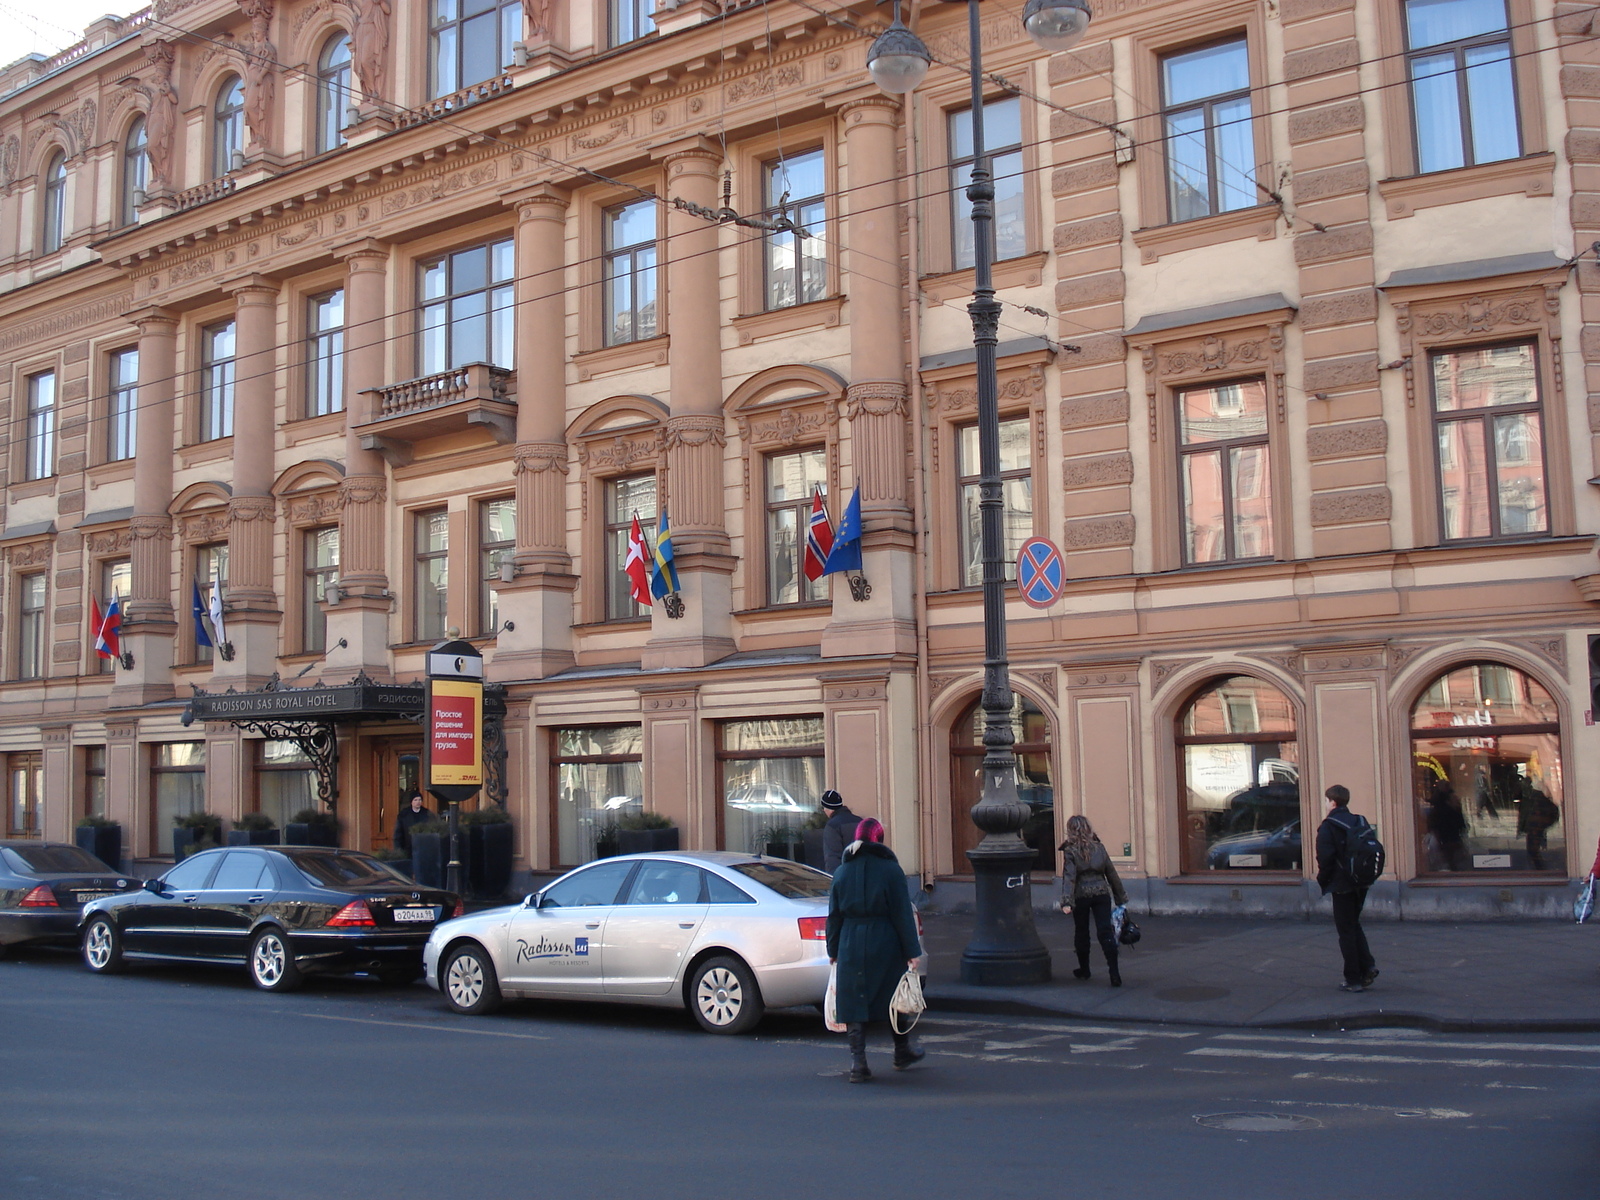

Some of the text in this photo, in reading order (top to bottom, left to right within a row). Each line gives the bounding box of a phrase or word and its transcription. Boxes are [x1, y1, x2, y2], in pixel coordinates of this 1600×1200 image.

[211, 694, 337, 712] RADISSON SAS ROYAL HOTEL
[378, 694, 424, 704] РЭДИССОН
[435, 710, 462, 719] Простое
[448, 732, 473, 740] импорта
[435, 742, 458, 750] грузов.
[516, 935, 573, 964] Radisson
